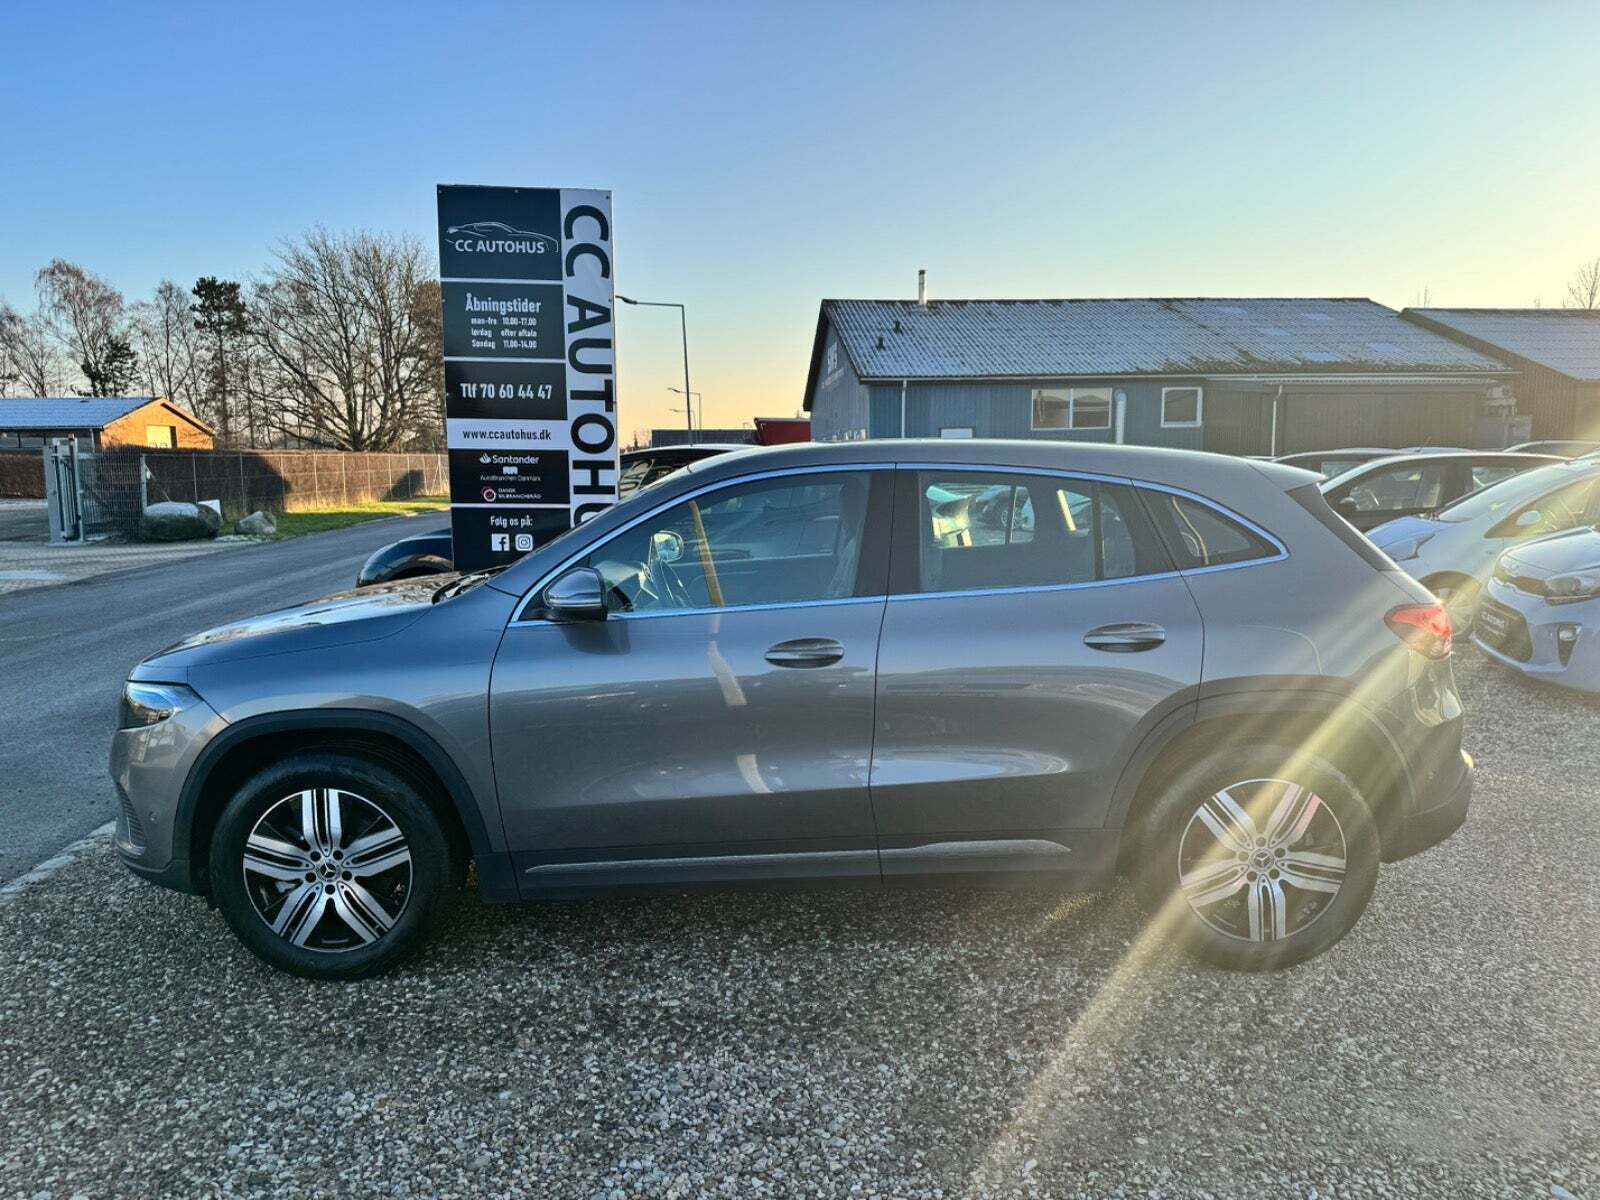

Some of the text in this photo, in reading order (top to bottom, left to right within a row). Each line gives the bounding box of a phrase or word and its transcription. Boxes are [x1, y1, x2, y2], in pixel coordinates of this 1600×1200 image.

[455, 239, 545, 254] CC AUTOHUS
[564, 205, 609, 279] CC
[465, 292, 542, 315] Åbningstider
[460, 382, 553, 400] Tlf 70 60 44 47
[462, 429, 551, 441] www.ccautohus.dk
[492, 455, 539, 464] Santander
[490, 514, 533, 529] Følg os på:
